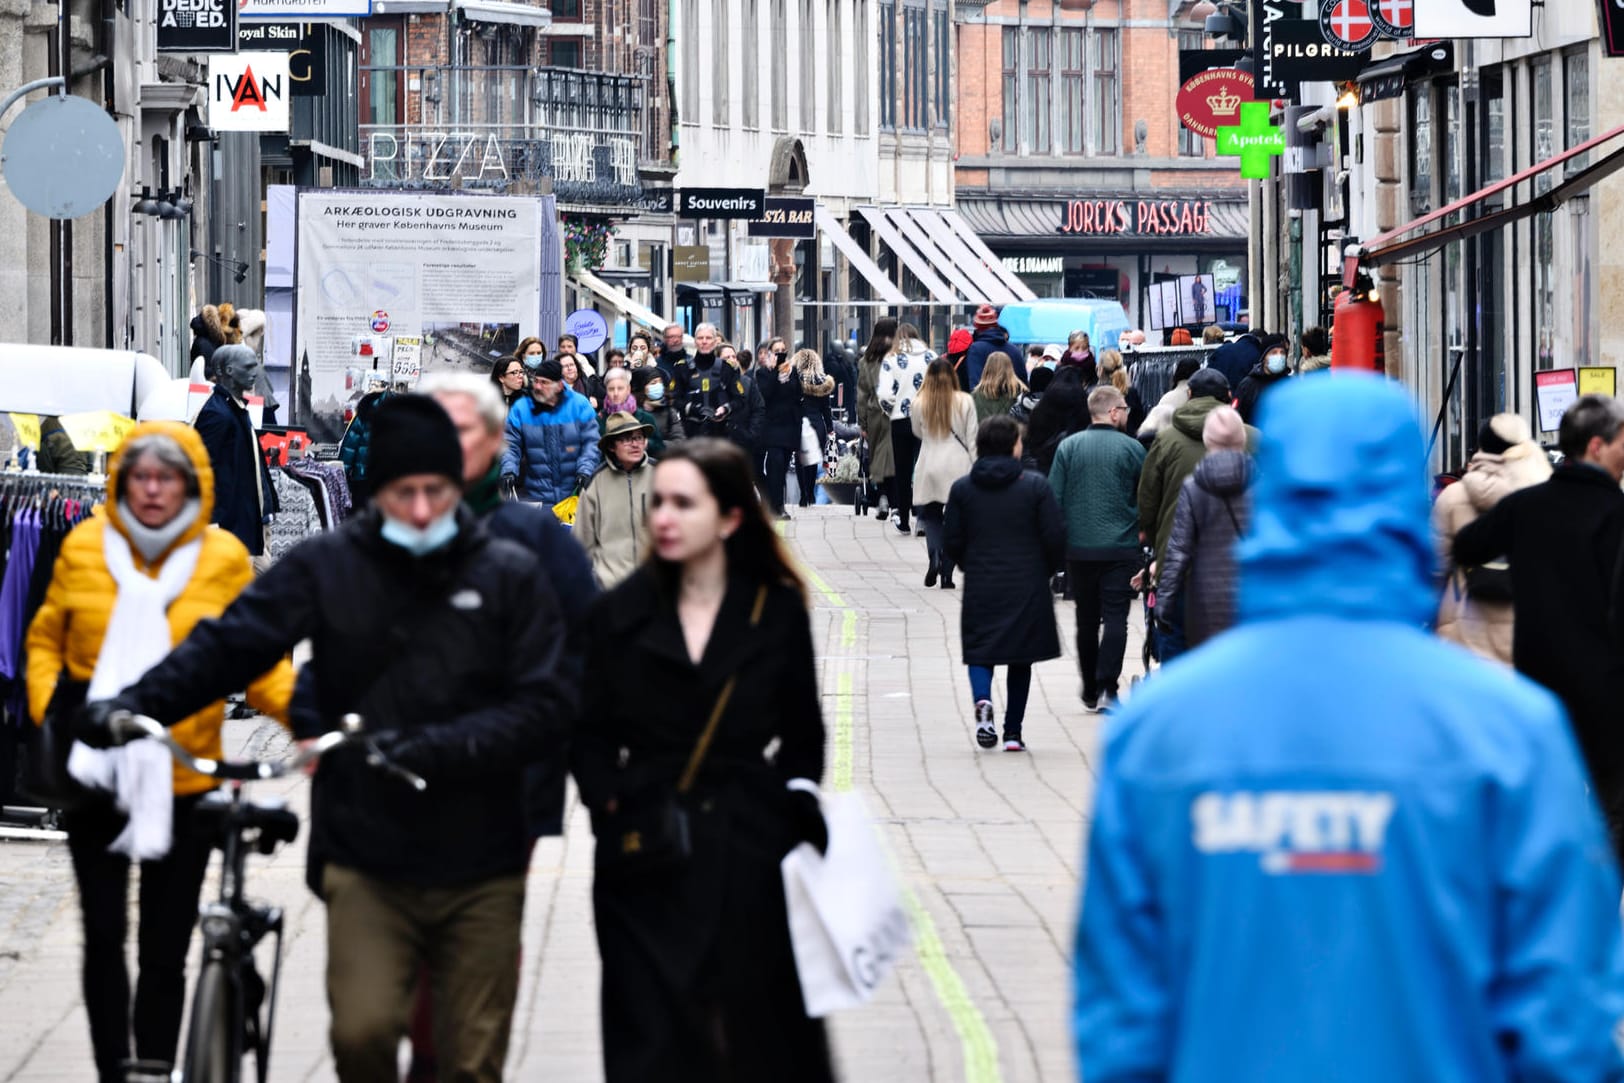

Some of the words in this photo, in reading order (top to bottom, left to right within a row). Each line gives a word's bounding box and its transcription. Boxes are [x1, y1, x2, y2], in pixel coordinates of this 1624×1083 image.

[163, 0, 223, 11] DEDIC
[239, 26, 265, 40] oyal
[268, 26, 297, 39] Skin
[216, 64, 281, 112] IVAN
[1185, 71, 1237, 93] KØBENHAVNS
[1228, 133, 1284, 148] Apotek
[688, 196, 756, 210] Souvenirs
[324, 206, 422, 217] ARKÆOLOGISK
[426, 207, 517, 219] UDGRAVNING
[787, 211, 813, 224] BAR
[1063, 200, 1126, 233] JORCKS
[1137, 200, 1212, 234] PASSAGE
[337, 220, 356, 229] Her
[358, 222, 391, 231] graver
[394, 220, 456, 230] Københavns
[458, 222, 503, 231] Museum
[1189, 790, 1395, 854] SAFETY
